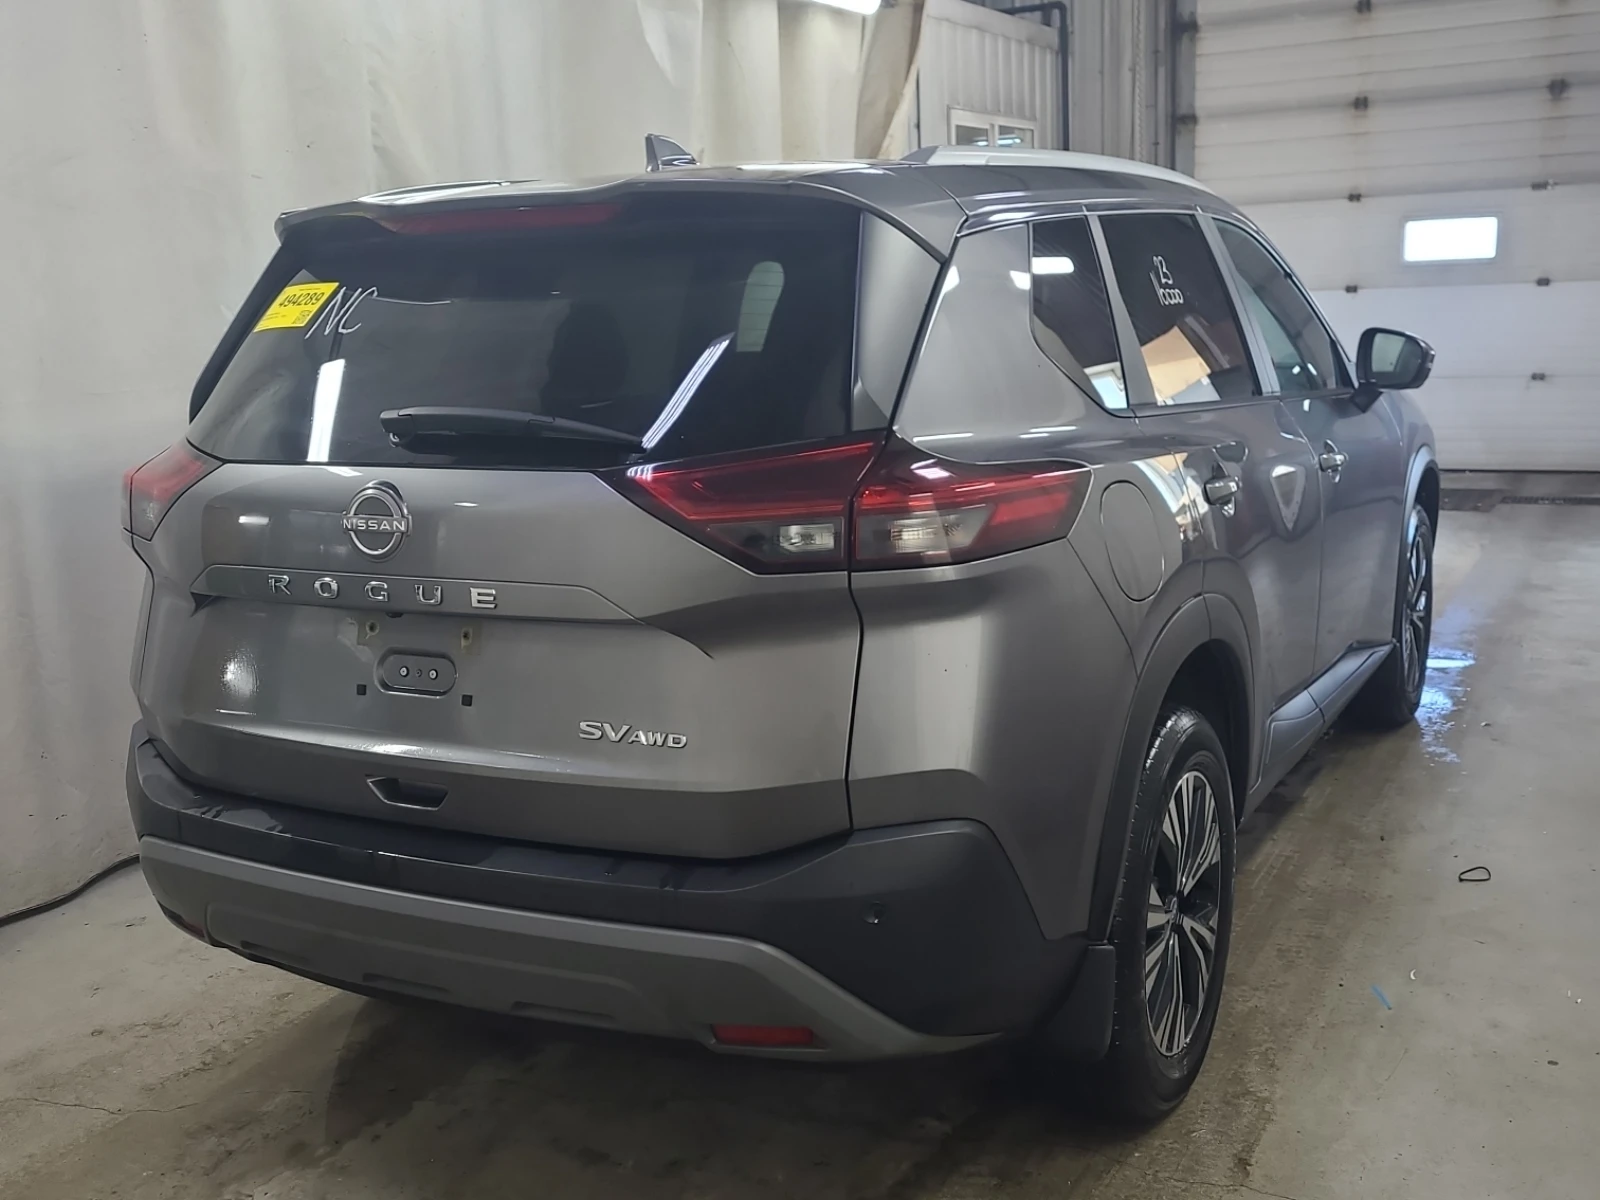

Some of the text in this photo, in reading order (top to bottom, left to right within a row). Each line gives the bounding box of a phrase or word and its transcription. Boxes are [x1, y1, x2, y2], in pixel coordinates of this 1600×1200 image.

[278, 292, 325, 308] 494289
[343, 518, 405, 531] NISSAN
[268, 574, 497, 610] ROGUE
